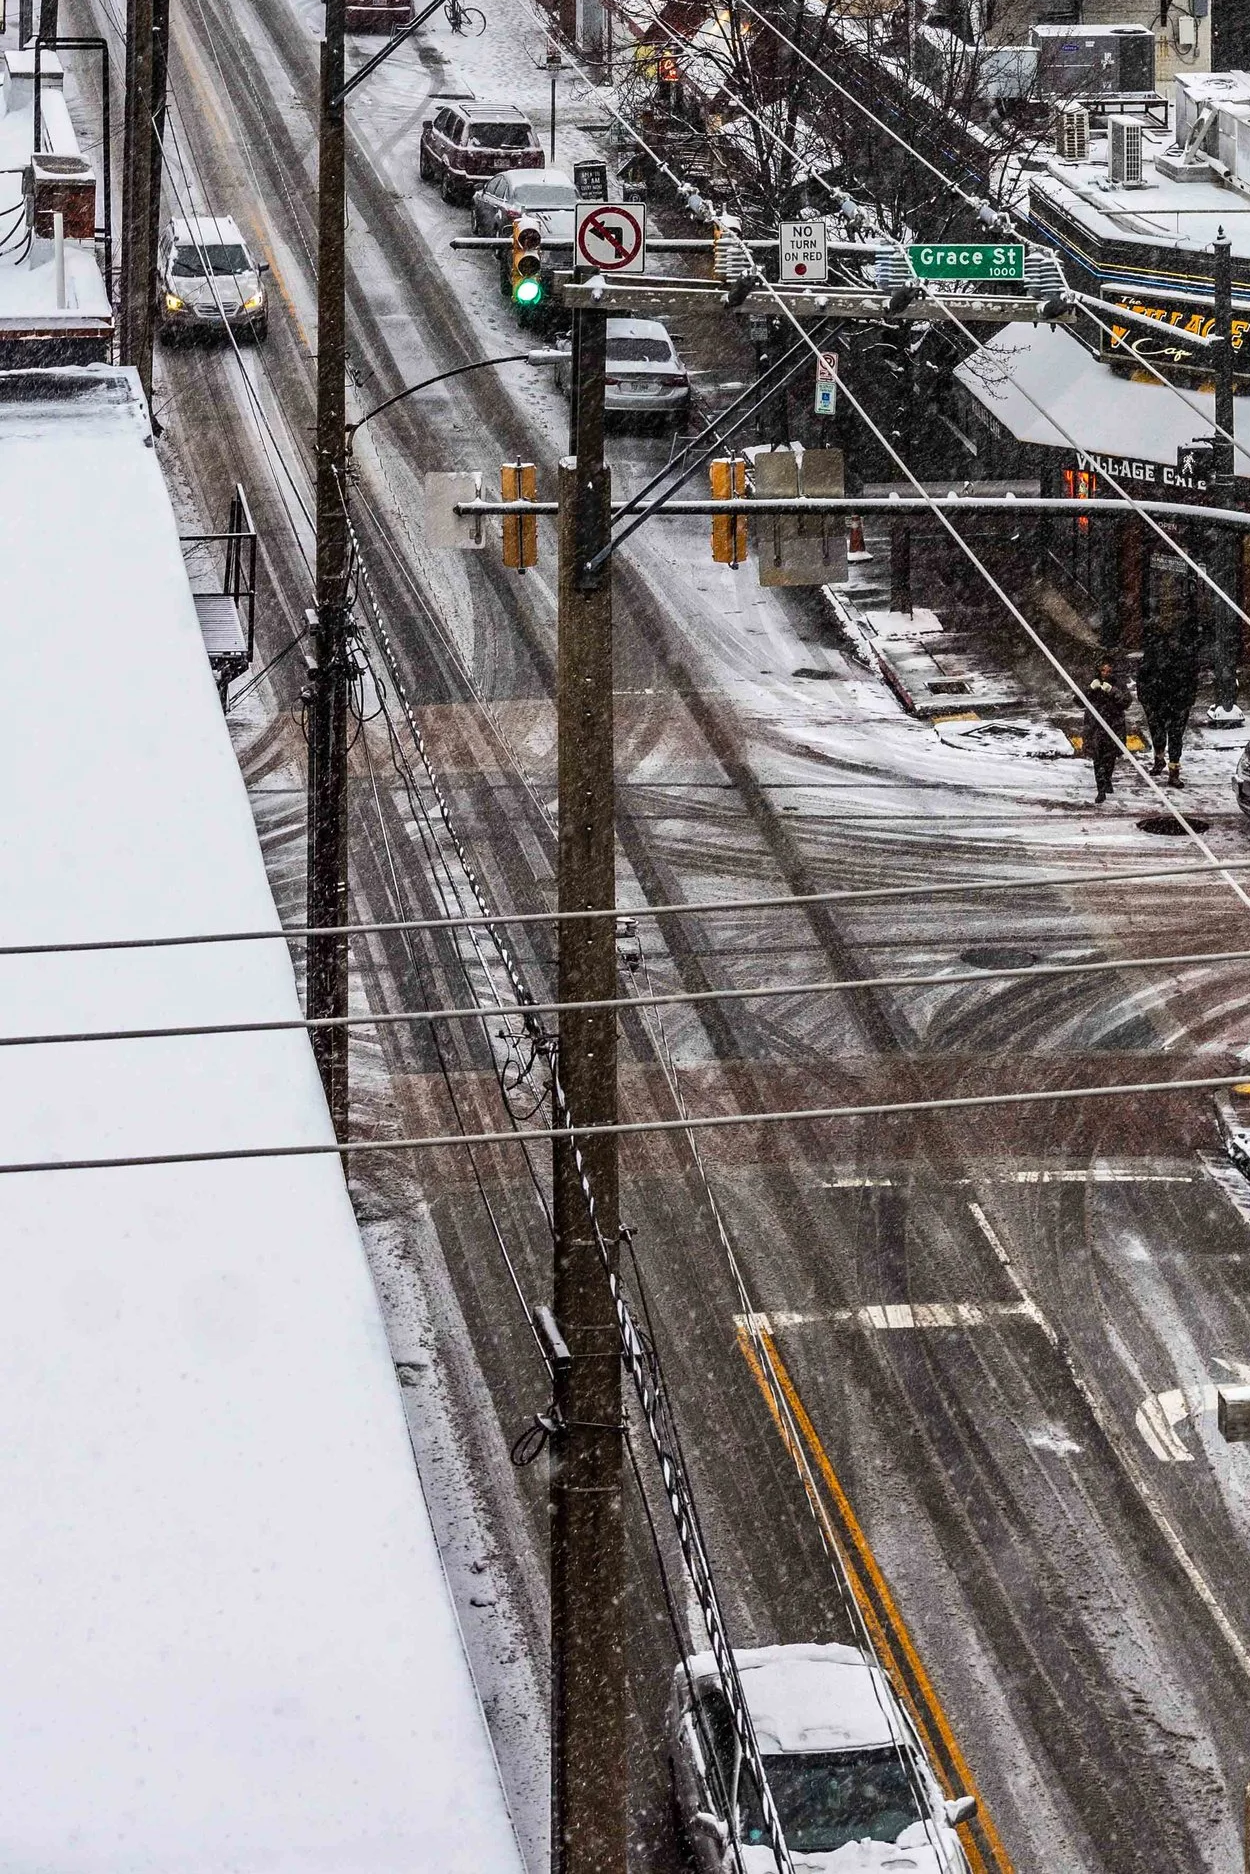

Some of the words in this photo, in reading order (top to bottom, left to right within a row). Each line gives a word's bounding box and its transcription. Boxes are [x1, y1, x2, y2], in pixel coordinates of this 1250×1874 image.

[792, 226, 813, 238] NO
[789, 239, 817, 250] TURN
[784, 252, 799, 262] ON
[802, 251, 823, 262] RED
[920, 248, 983, 265] Grace
[992, 247, 1016, 265] St
[989, 267, 1017, 276] 1000
[1120, 295, 1142, 305] The
[1075, 451, 1156, 483] VILLAGE
[1157, 521, 1178, 531] OPEN
